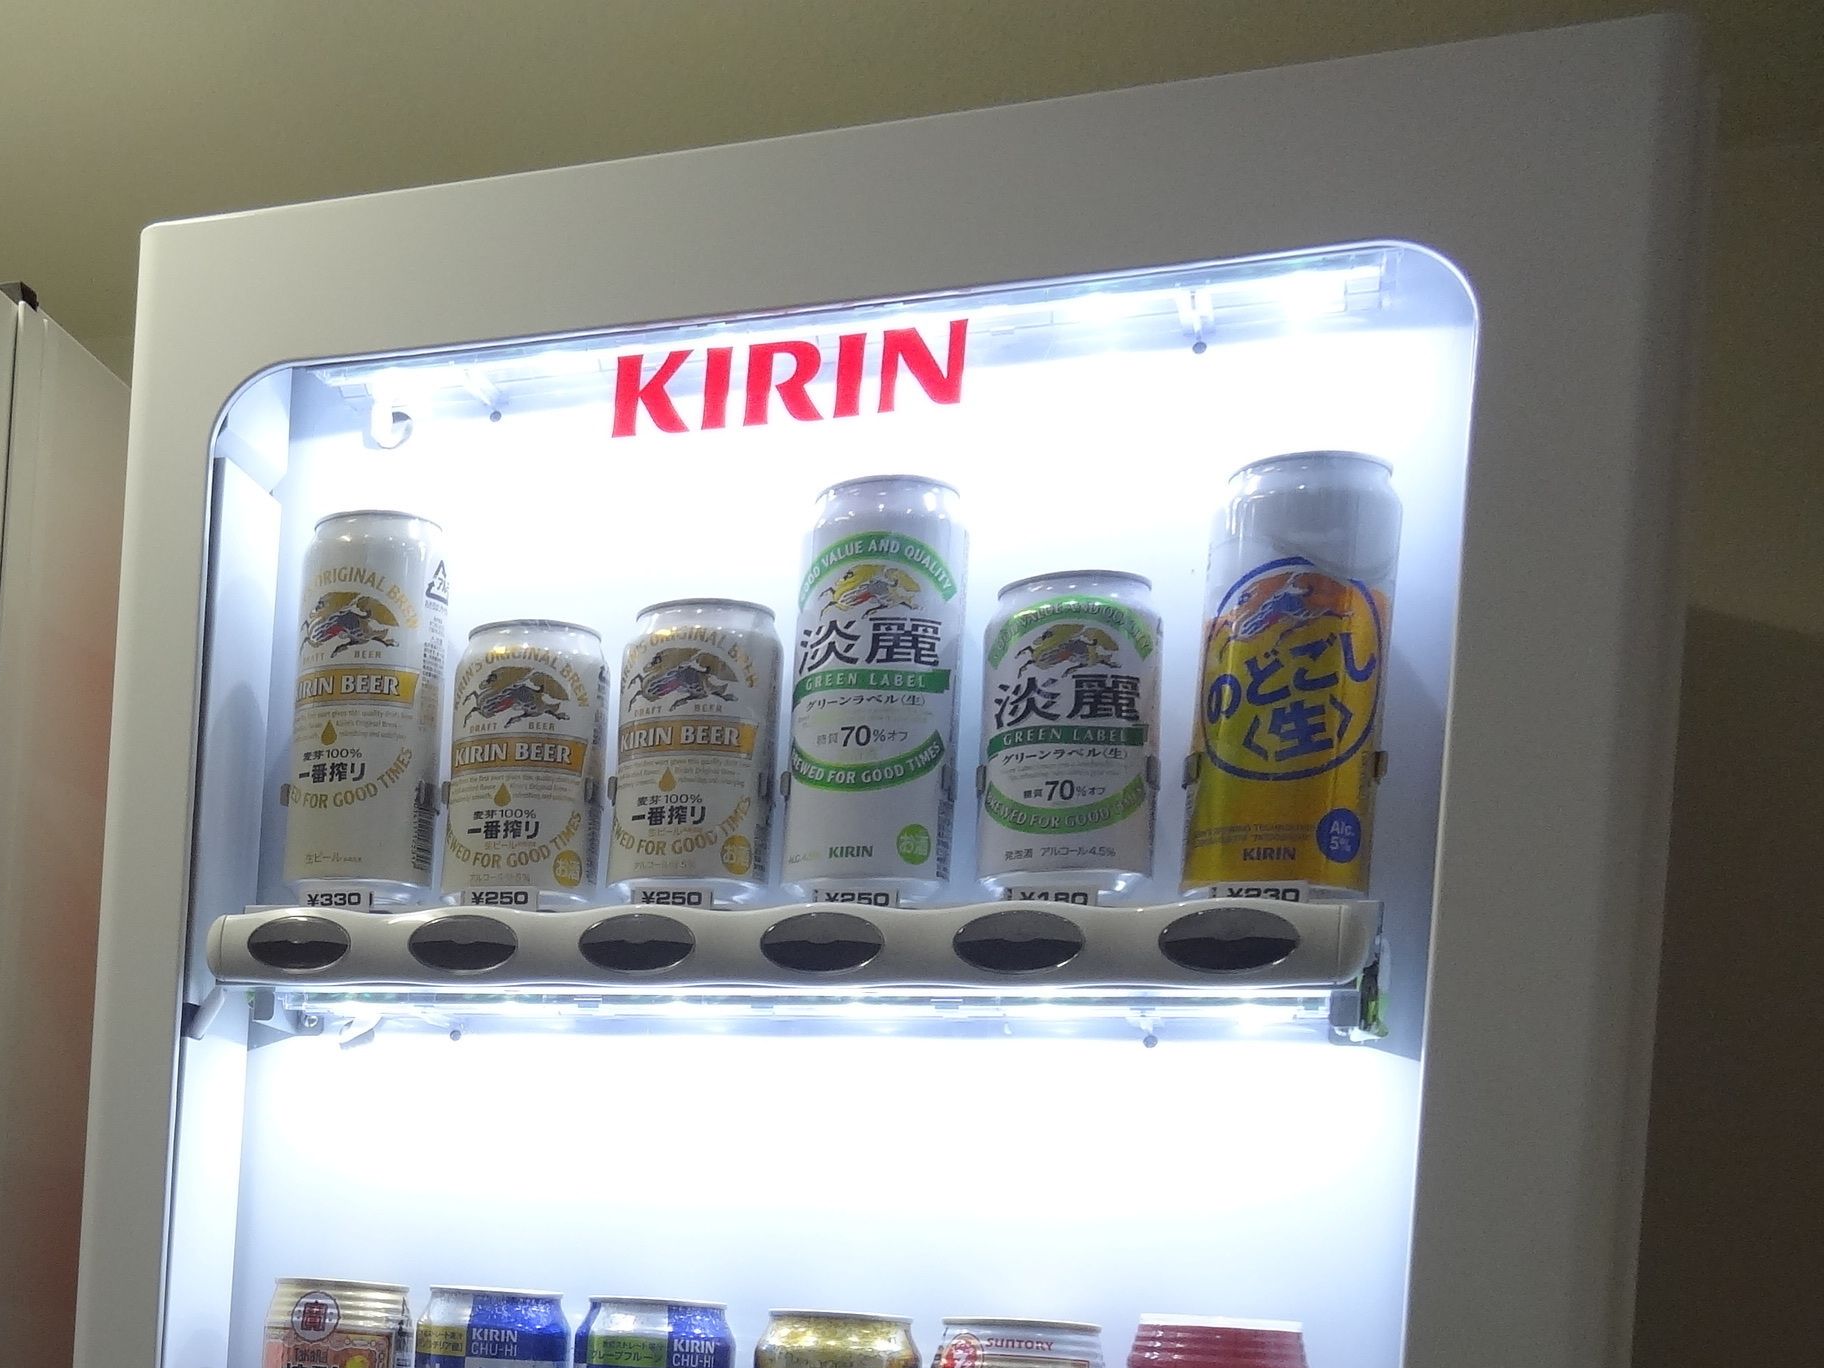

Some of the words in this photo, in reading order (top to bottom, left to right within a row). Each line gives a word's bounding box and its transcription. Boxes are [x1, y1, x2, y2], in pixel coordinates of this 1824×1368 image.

[611, 318, 969, 438] KIRIN
[821, 540, 865, 568] VALUE
[867, 538, 901, 555] AND
[904, 544, 953, 593] QUALITY
[799, 615, 943, 675] 淡麗
[338, 671, 401, 698] BEER
[805, 673, 858, 690] GREEN
[868, 672, 926, 688] LABEL
[1206, 633, 1377, 727] のどごし
[993, 672, 1141, 729] 淡麗
[620, 728, 673, 754] KIRIN
[679, 725, 742, 748] BEER
[1002, 728, 1063, 745] GREEN
[1072, 727, 1128, 743] LABEL
[302, 747, 364, 762] 麦芽100%
[454, 741, 508, 766] KIRIN
[514, 741, 572, 764] BEER
[827, 770, 857, 784] FOR
[862, 766, 905, 784] GOOD
[906, 742, 941, 773] TIMES
[298, 762, 366, 784] 一番搾り
[302, 793, 329, 809] FOR
[332, 782, 379, 807] GOOD
[636, 794, 703, 807] 麦芽100%
[473, 808, 537, 821] 麦芽100%
[631, 806, 707, 826] 一番搾り
[1028, 812, 1062, 829] FOR
[1066, 806, 1112, 828] GOOD
[467, 820, 540, 840] 一番搾り
[1329, 820, 1355, 836] Alc.
[472, 852, 502, 869] FOR
[506, 845, 551, 868] GOOD
[549, 810, 582, 851] TIMES
[636, 840, 667, 856] FOR
[671, 832, 719, 855] GOOD
[828, 845, 874, 859] KIRIN
[1242, 847, 1296, 861] KIRIN
[307, 891, 362, 907] ¥330
[471, 890, 529, 905] ¥250
[641, 890, 703, 905] ¥250
[824, 891, 890, 906] ¥250
[471, 1327, 518, 1343] KIRIN
[985, 1337, 1054, 1351] SUNTORY
[470, 1342, 518, 1357] CHU-HI
[673, 1339, 717, 1354] KIRIN
[672, 1354, 715, 1368] CHU-HI
